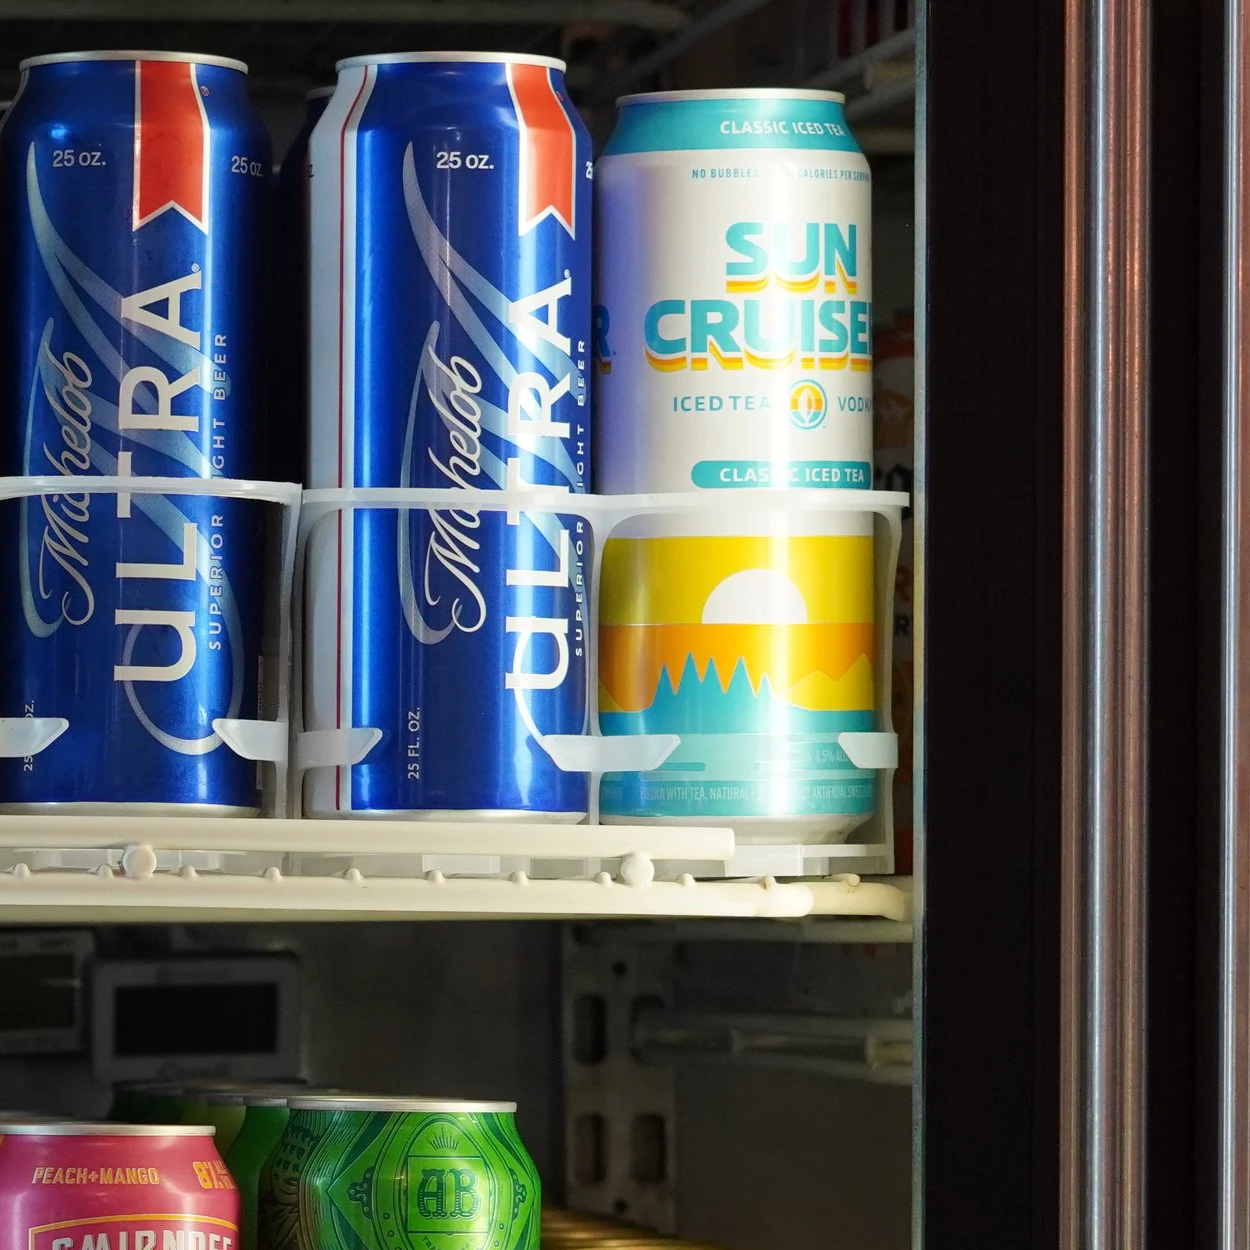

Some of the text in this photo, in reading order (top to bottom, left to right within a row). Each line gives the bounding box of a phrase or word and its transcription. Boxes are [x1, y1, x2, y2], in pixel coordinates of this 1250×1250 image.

[720, 121, 845, 137] CLASSIC ICED TEA
[52, 150, 75, 167] 25
[436, 152, 462, 170] 25
[692, 168, 706, 178] NO
[725, 222, 858, 293] SUN
[643, 300, 872, 371] CRUISE
[213, 334, 228, 401] BEER
[577, 340, 586, 407] BEER
[673, 395, 771, 412] ICED TEA
[805, 467, 864, 482] ICED TEA
[208, 514, 224, 651] SUPERIOR
[575, 520, 584, 657] SUPERIOR
[407, 706, 420, 780] 25 FL. OZ.
[32, 1167, 160, 1185] PEACH+MANGO
